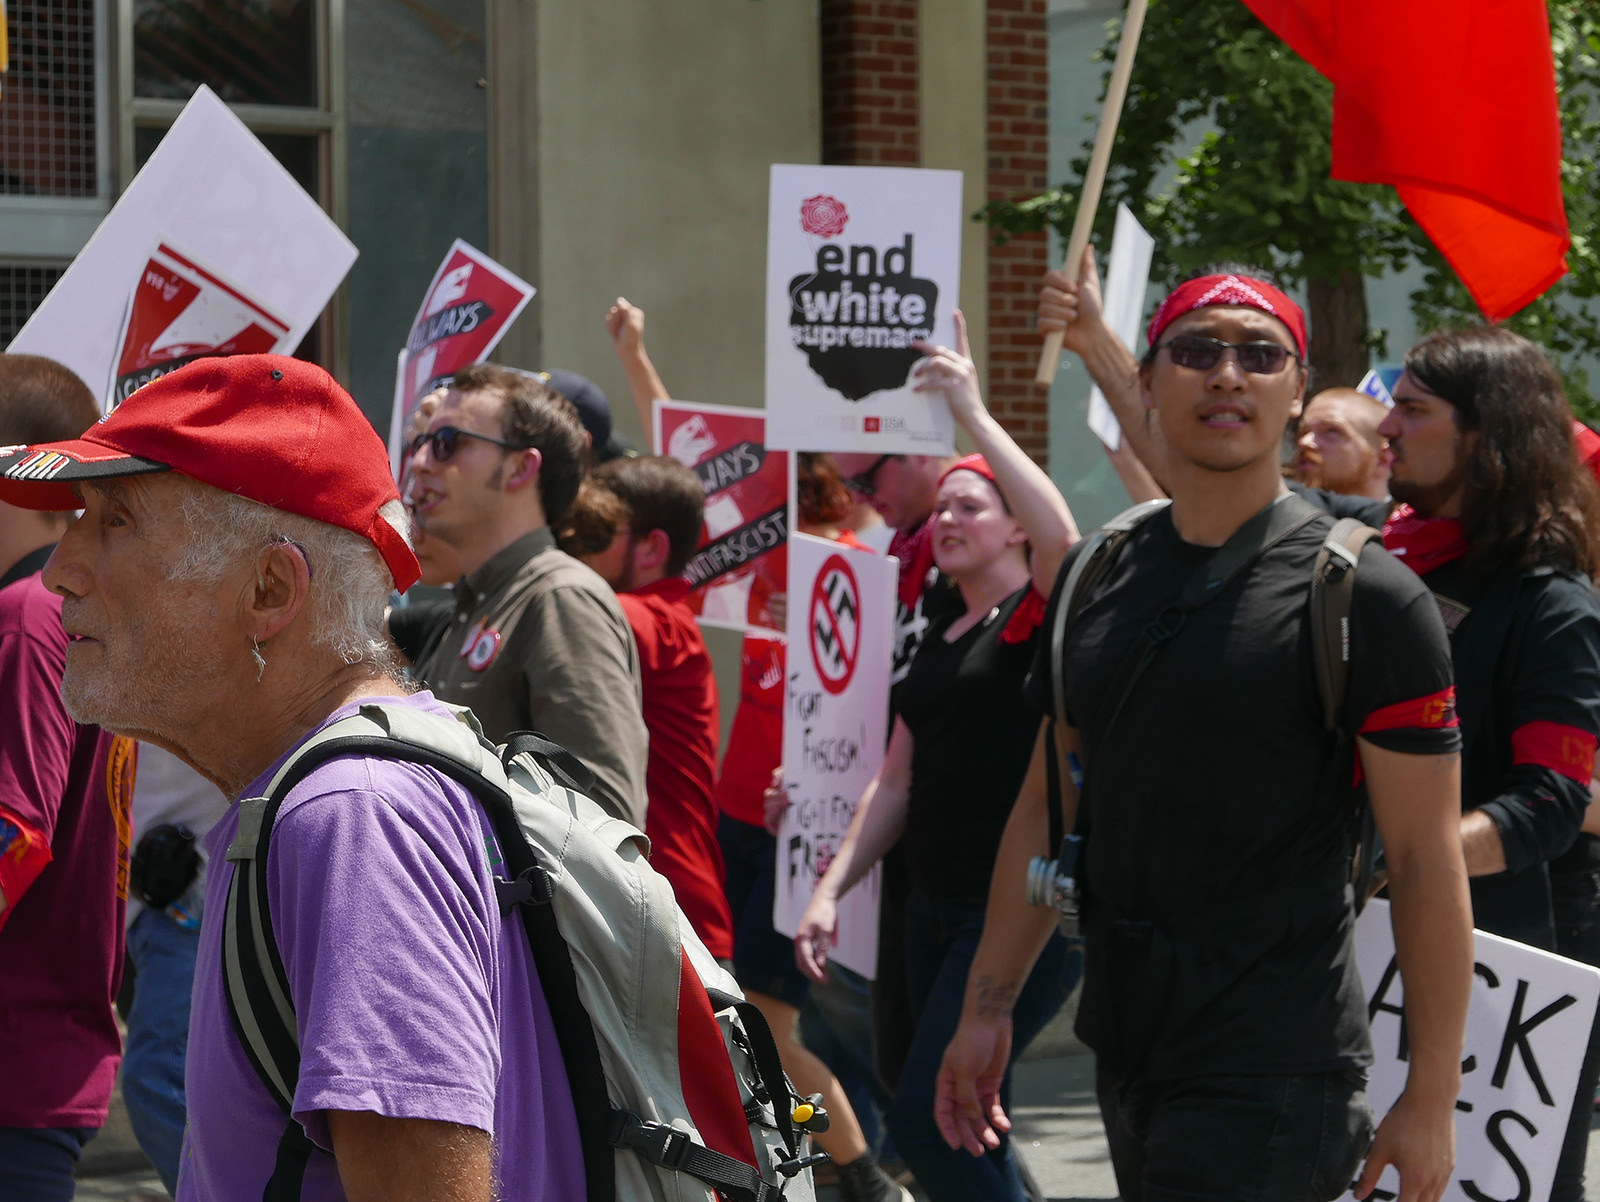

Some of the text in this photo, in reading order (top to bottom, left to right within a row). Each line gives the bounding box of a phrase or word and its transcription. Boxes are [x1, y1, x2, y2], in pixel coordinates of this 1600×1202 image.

[817, 233, 913, 276] end
[800, 281, 927, 324] white
[697, 442, 760, 494] WAYS
[682, 511, 787, 586] NTIFASCIST
